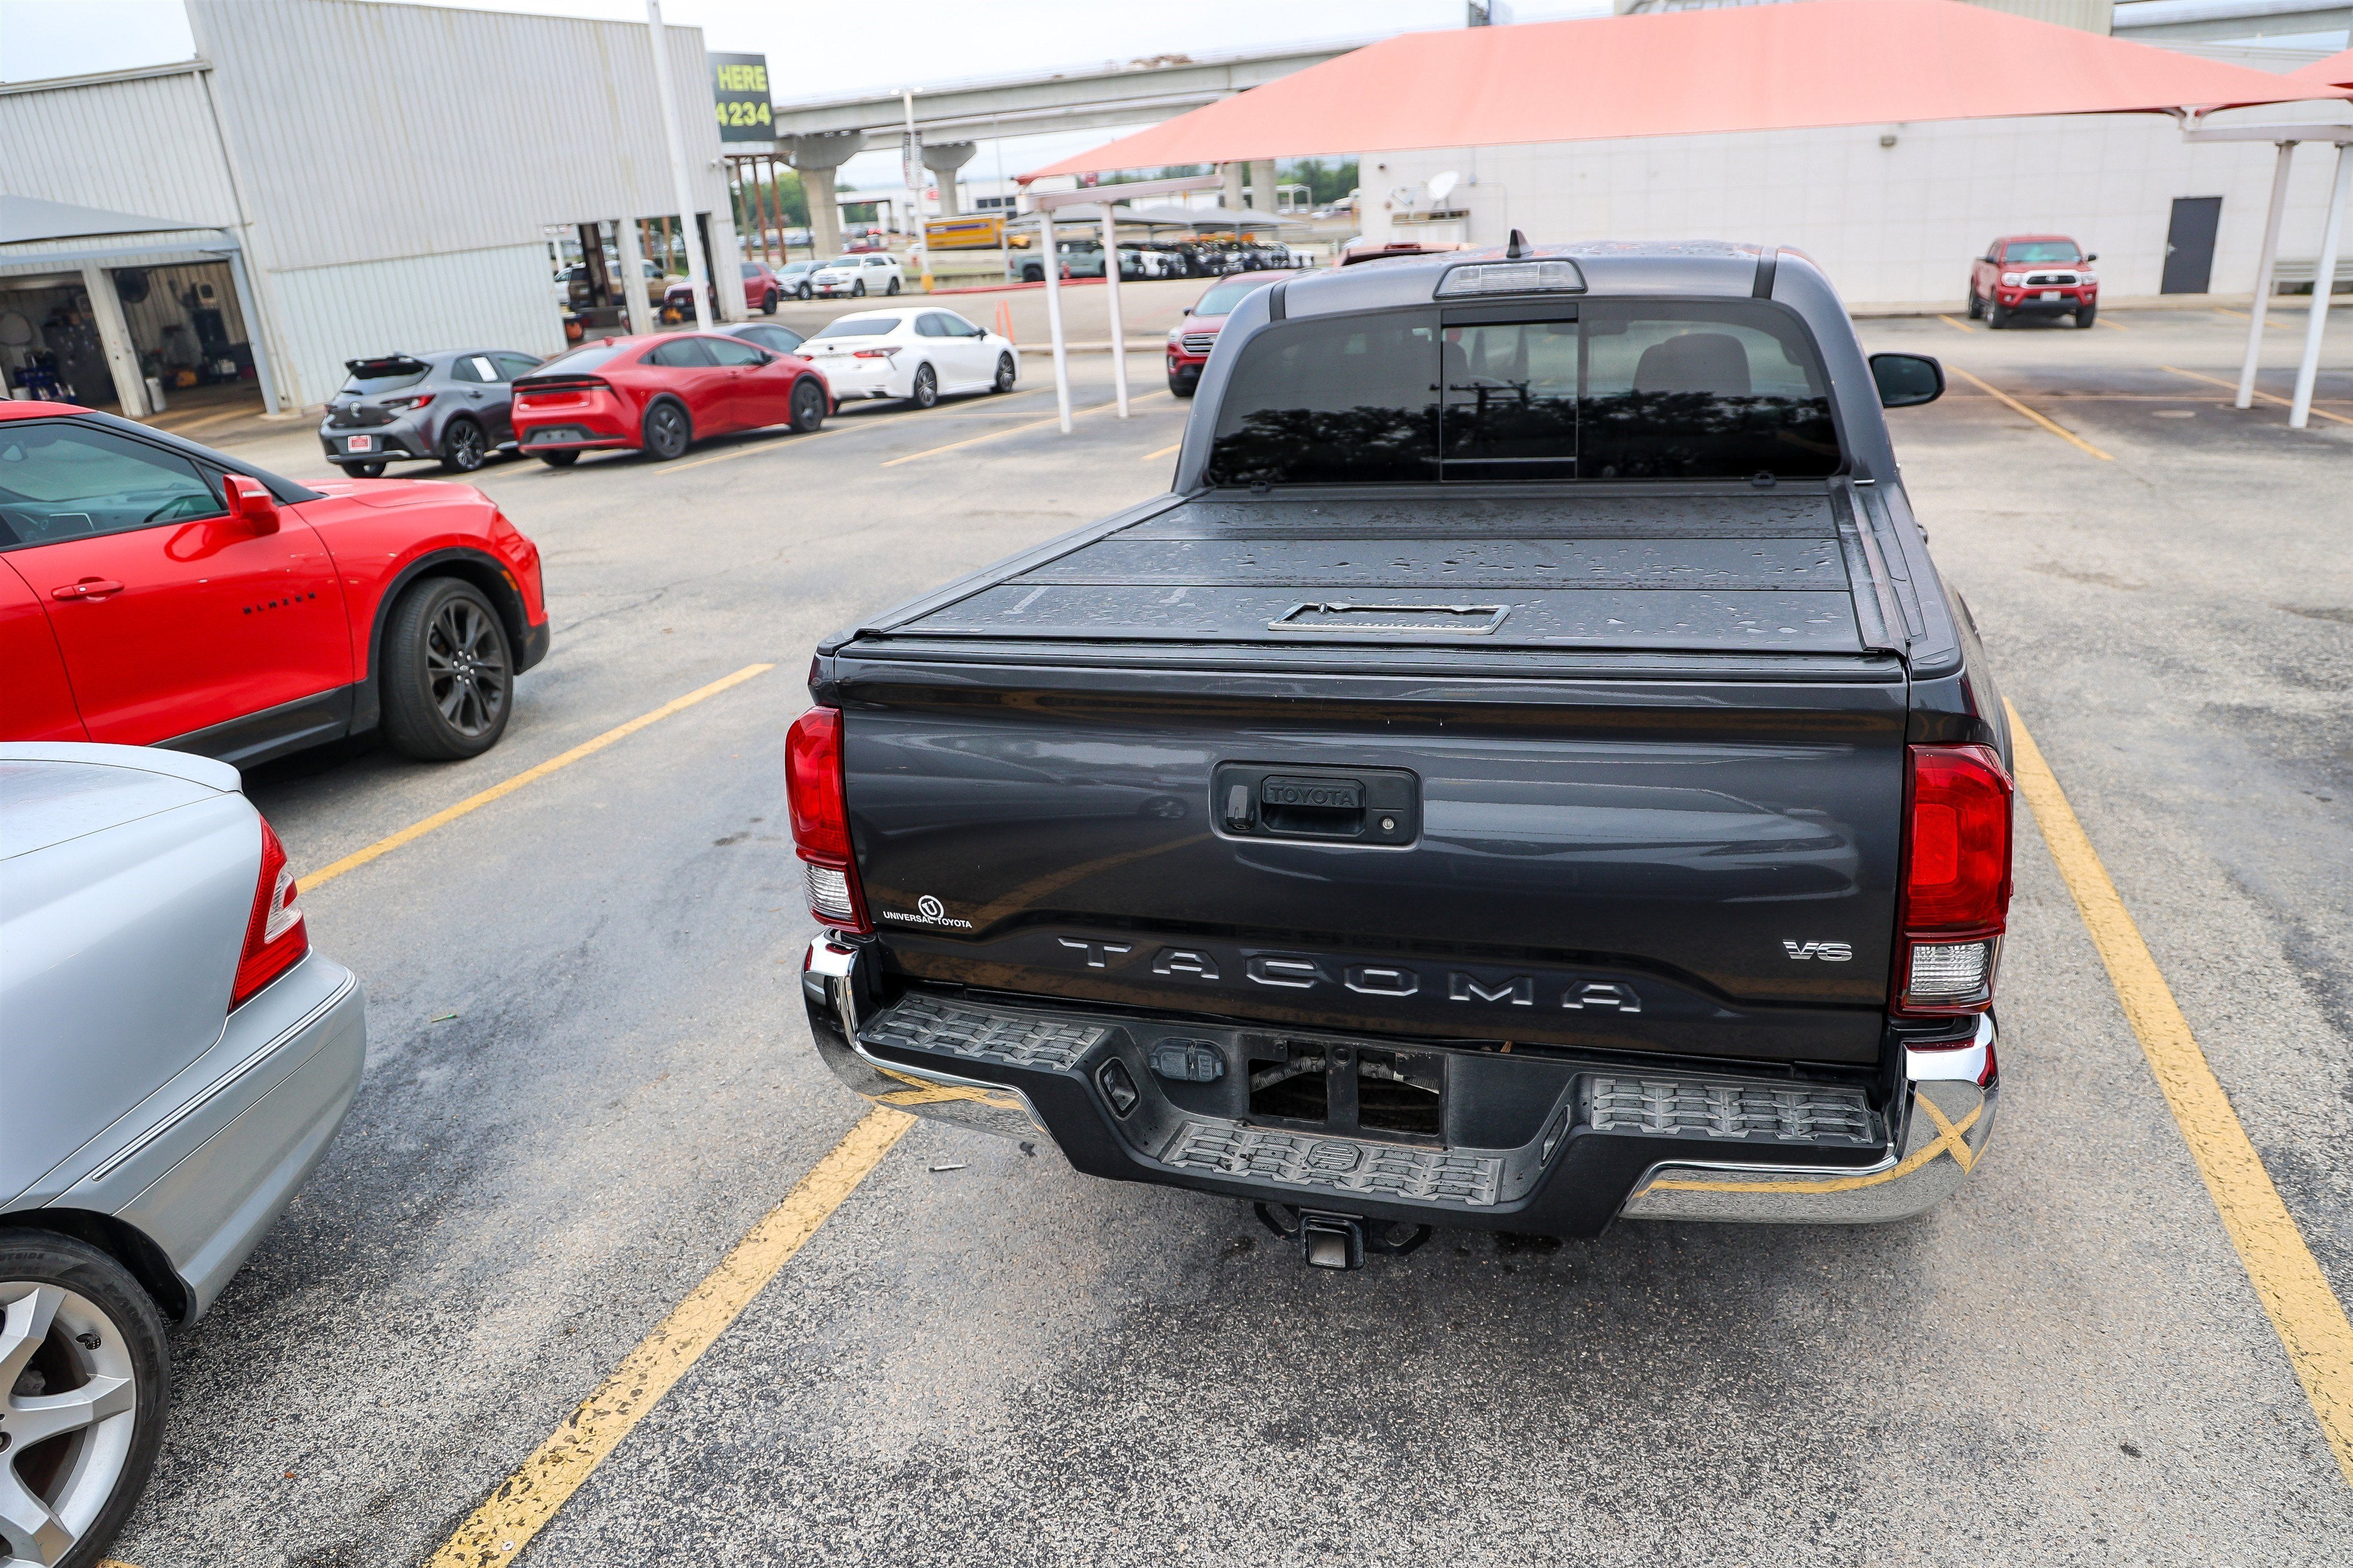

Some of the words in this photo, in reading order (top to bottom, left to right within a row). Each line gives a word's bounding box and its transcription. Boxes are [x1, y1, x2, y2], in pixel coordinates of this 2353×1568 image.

[717, 64, 768, 91] HERE
[715, 101, 772, 126] 4234
[1270, 785, 1356, 806] TOYOTA
[883, 911, 934, 924] UNIVERSAL
[937, 917, 973, 928] TOYOTA
[1783, 939, 1853, 961] V6
[1058, 937, 1642, 1012] TACOMA
